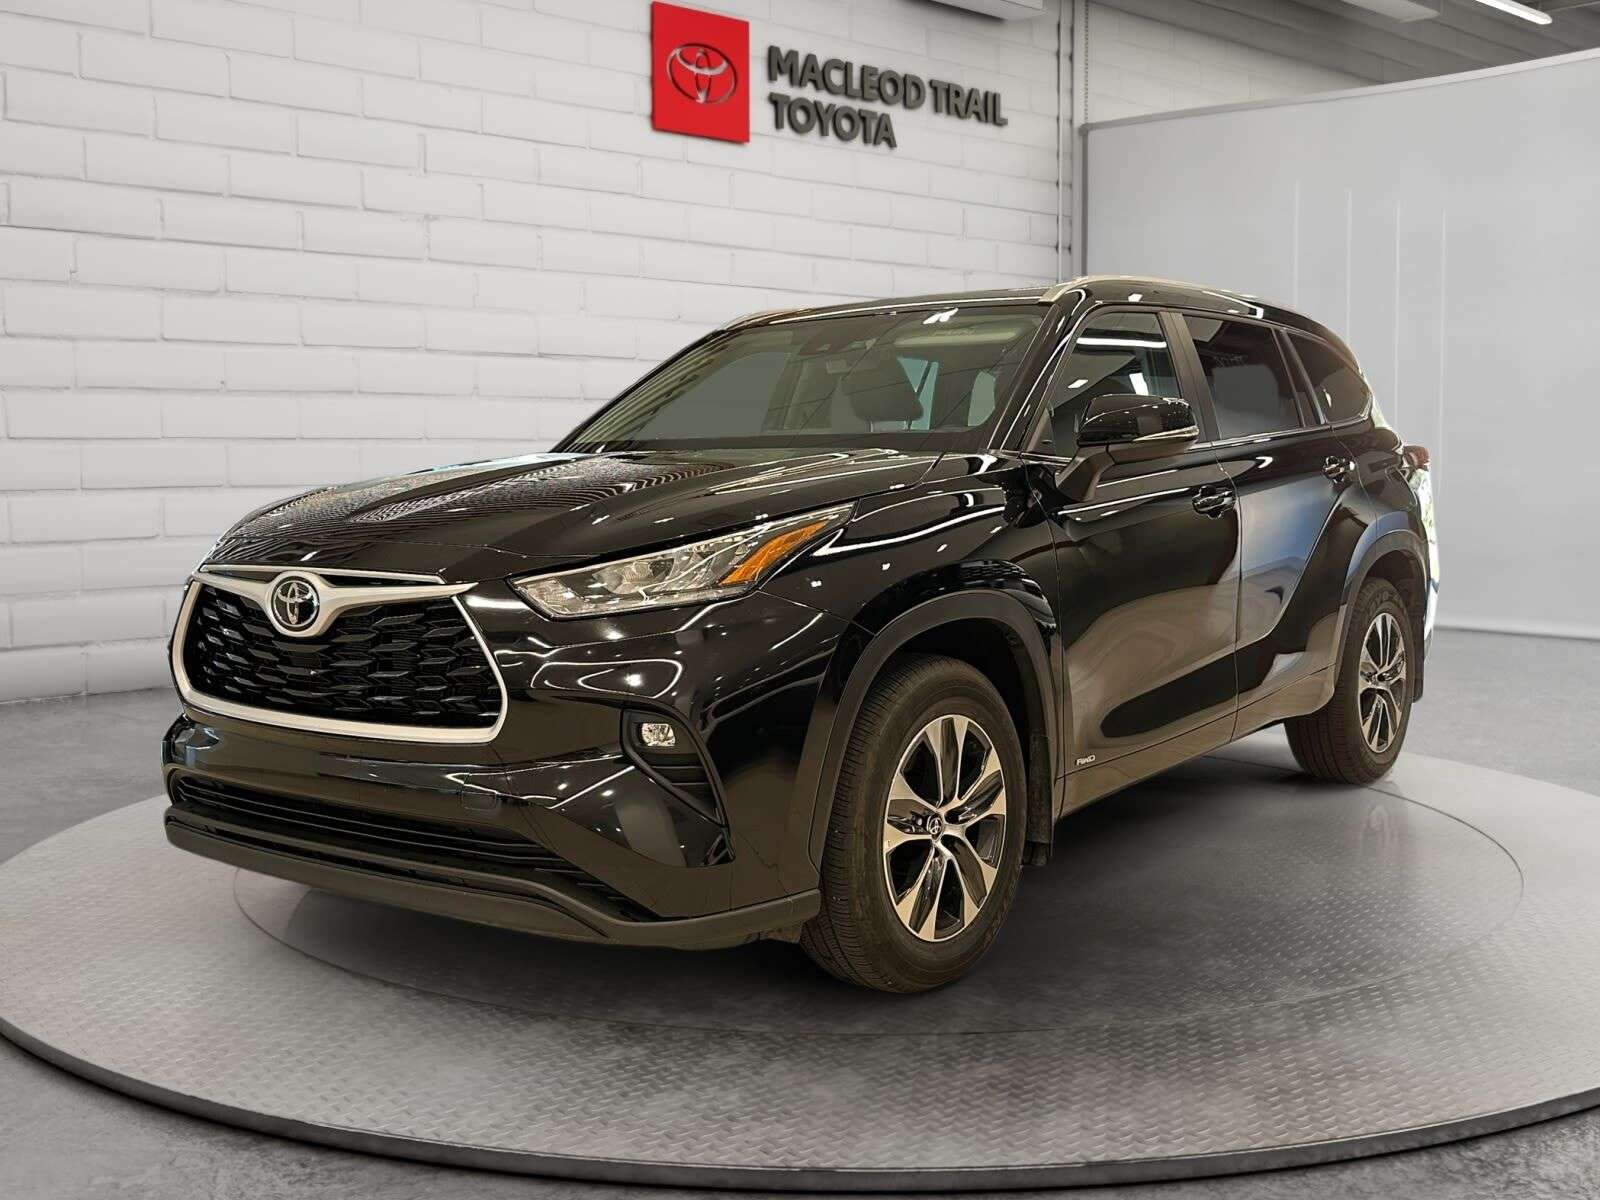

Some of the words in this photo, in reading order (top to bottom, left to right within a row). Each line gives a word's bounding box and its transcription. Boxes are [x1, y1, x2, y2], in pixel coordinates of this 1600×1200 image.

[768, 45, 925, 109] MACLEOD
[929, 79, 1008, 126] TRAIL
[769, 92, 897, 149] TOYOTA
